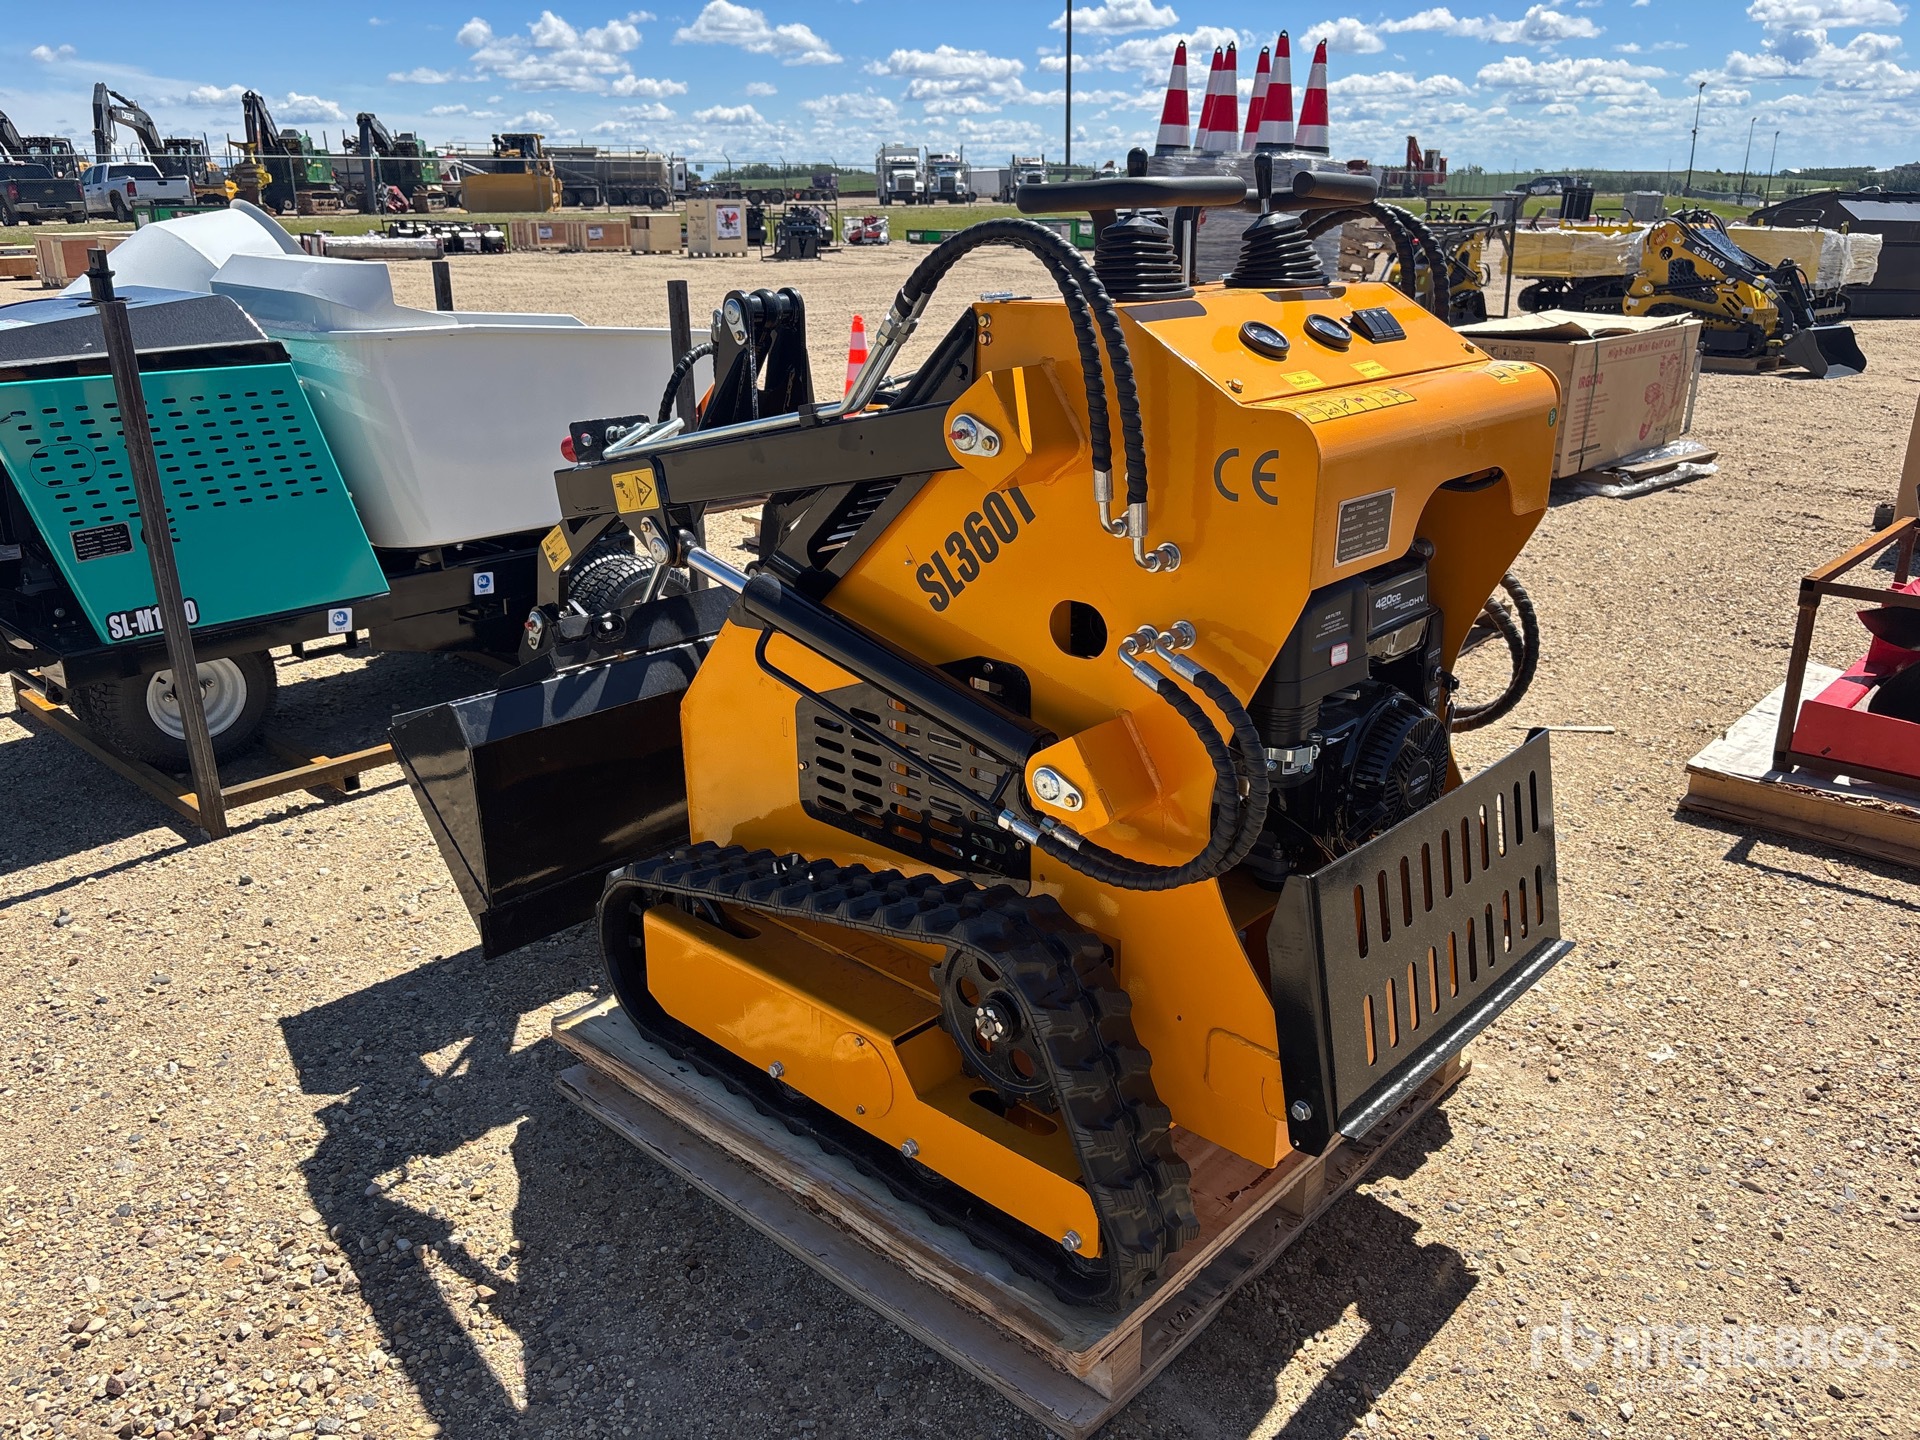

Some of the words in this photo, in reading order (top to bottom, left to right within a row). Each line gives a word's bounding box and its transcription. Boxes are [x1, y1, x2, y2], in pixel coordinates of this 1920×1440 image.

[121, 109, 136, 122] DEERE
[1692, 246, 1726, 269] SSL60
[1214, 448, 1279, 506] CE
[1375, 593, 1402, 609] 420cc
[1409, 594, 1425, 607] OHV
[108, 599, 198, 640] SL-M10
